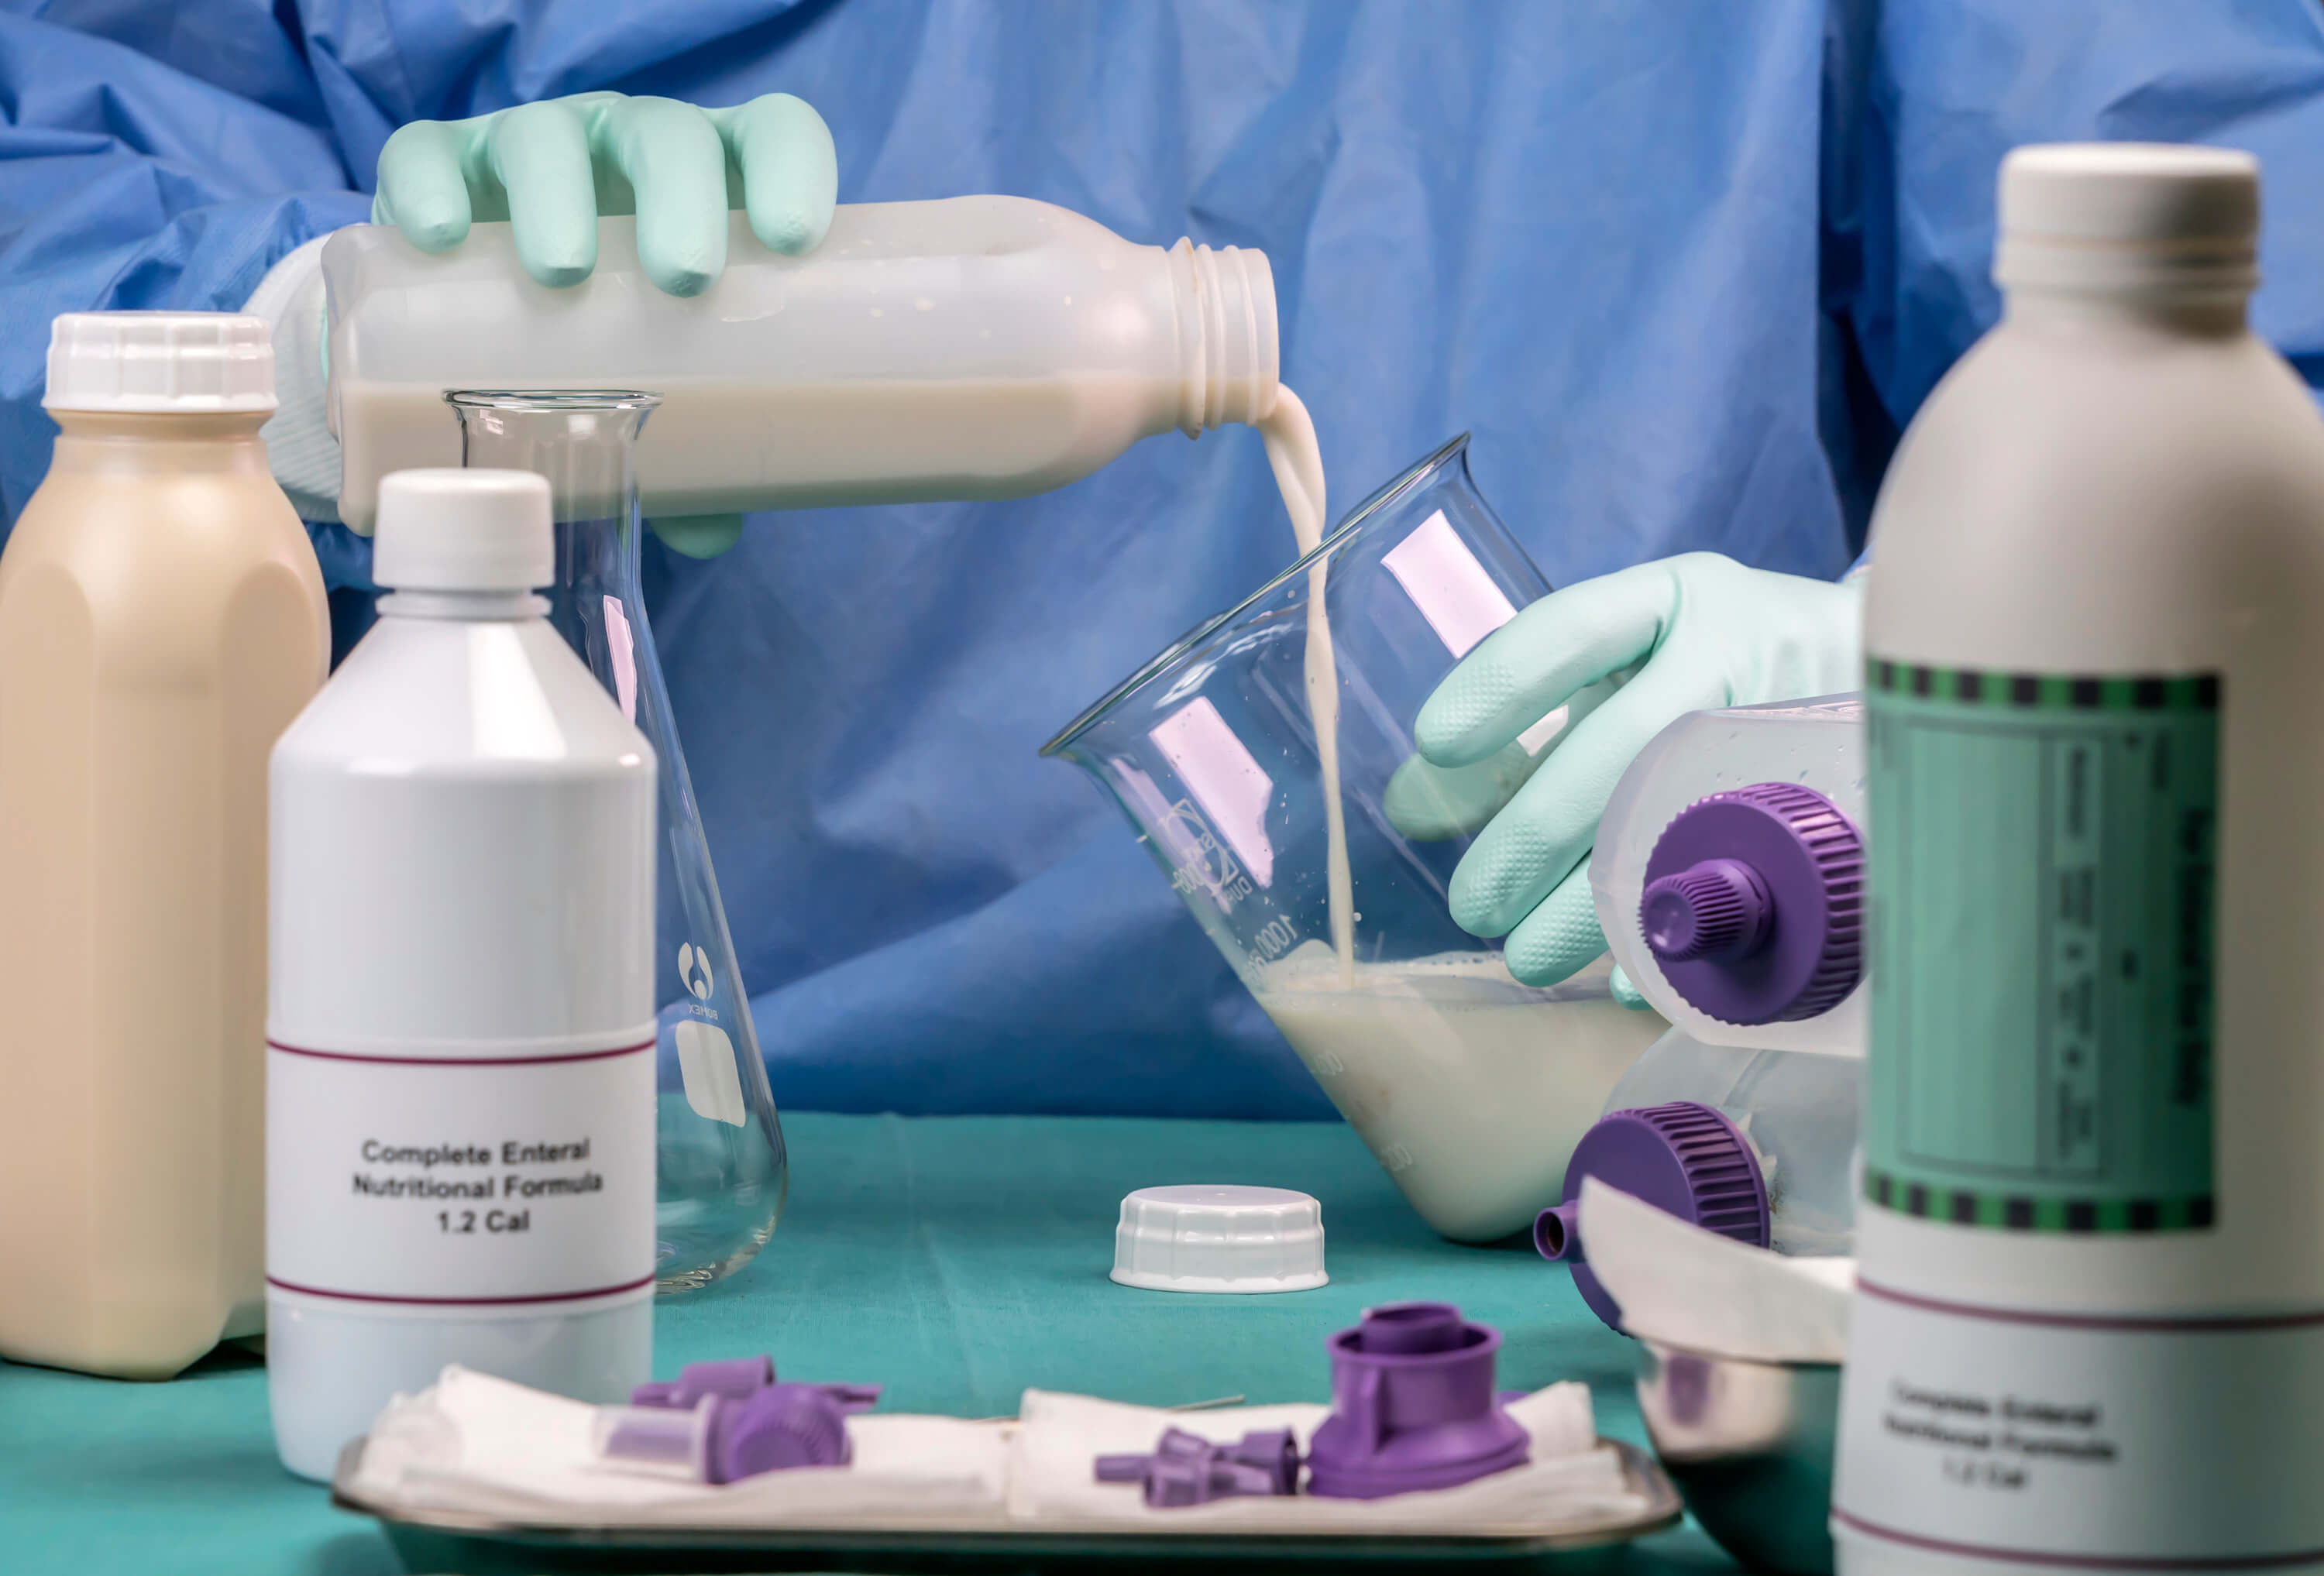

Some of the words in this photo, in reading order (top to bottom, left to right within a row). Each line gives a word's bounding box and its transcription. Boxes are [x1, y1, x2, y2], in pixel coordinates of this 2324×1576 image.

[362, 1139, 491, 1167] Complete
[503, 1136, 590, 1165] Enteral
[352, 1173, 493, 1199] Nutritional
[504, 1171, 603, 1198] Formula
[438, 1210, 476, 1234] 1.2
[486, 1209, 529, 1234] Cal
